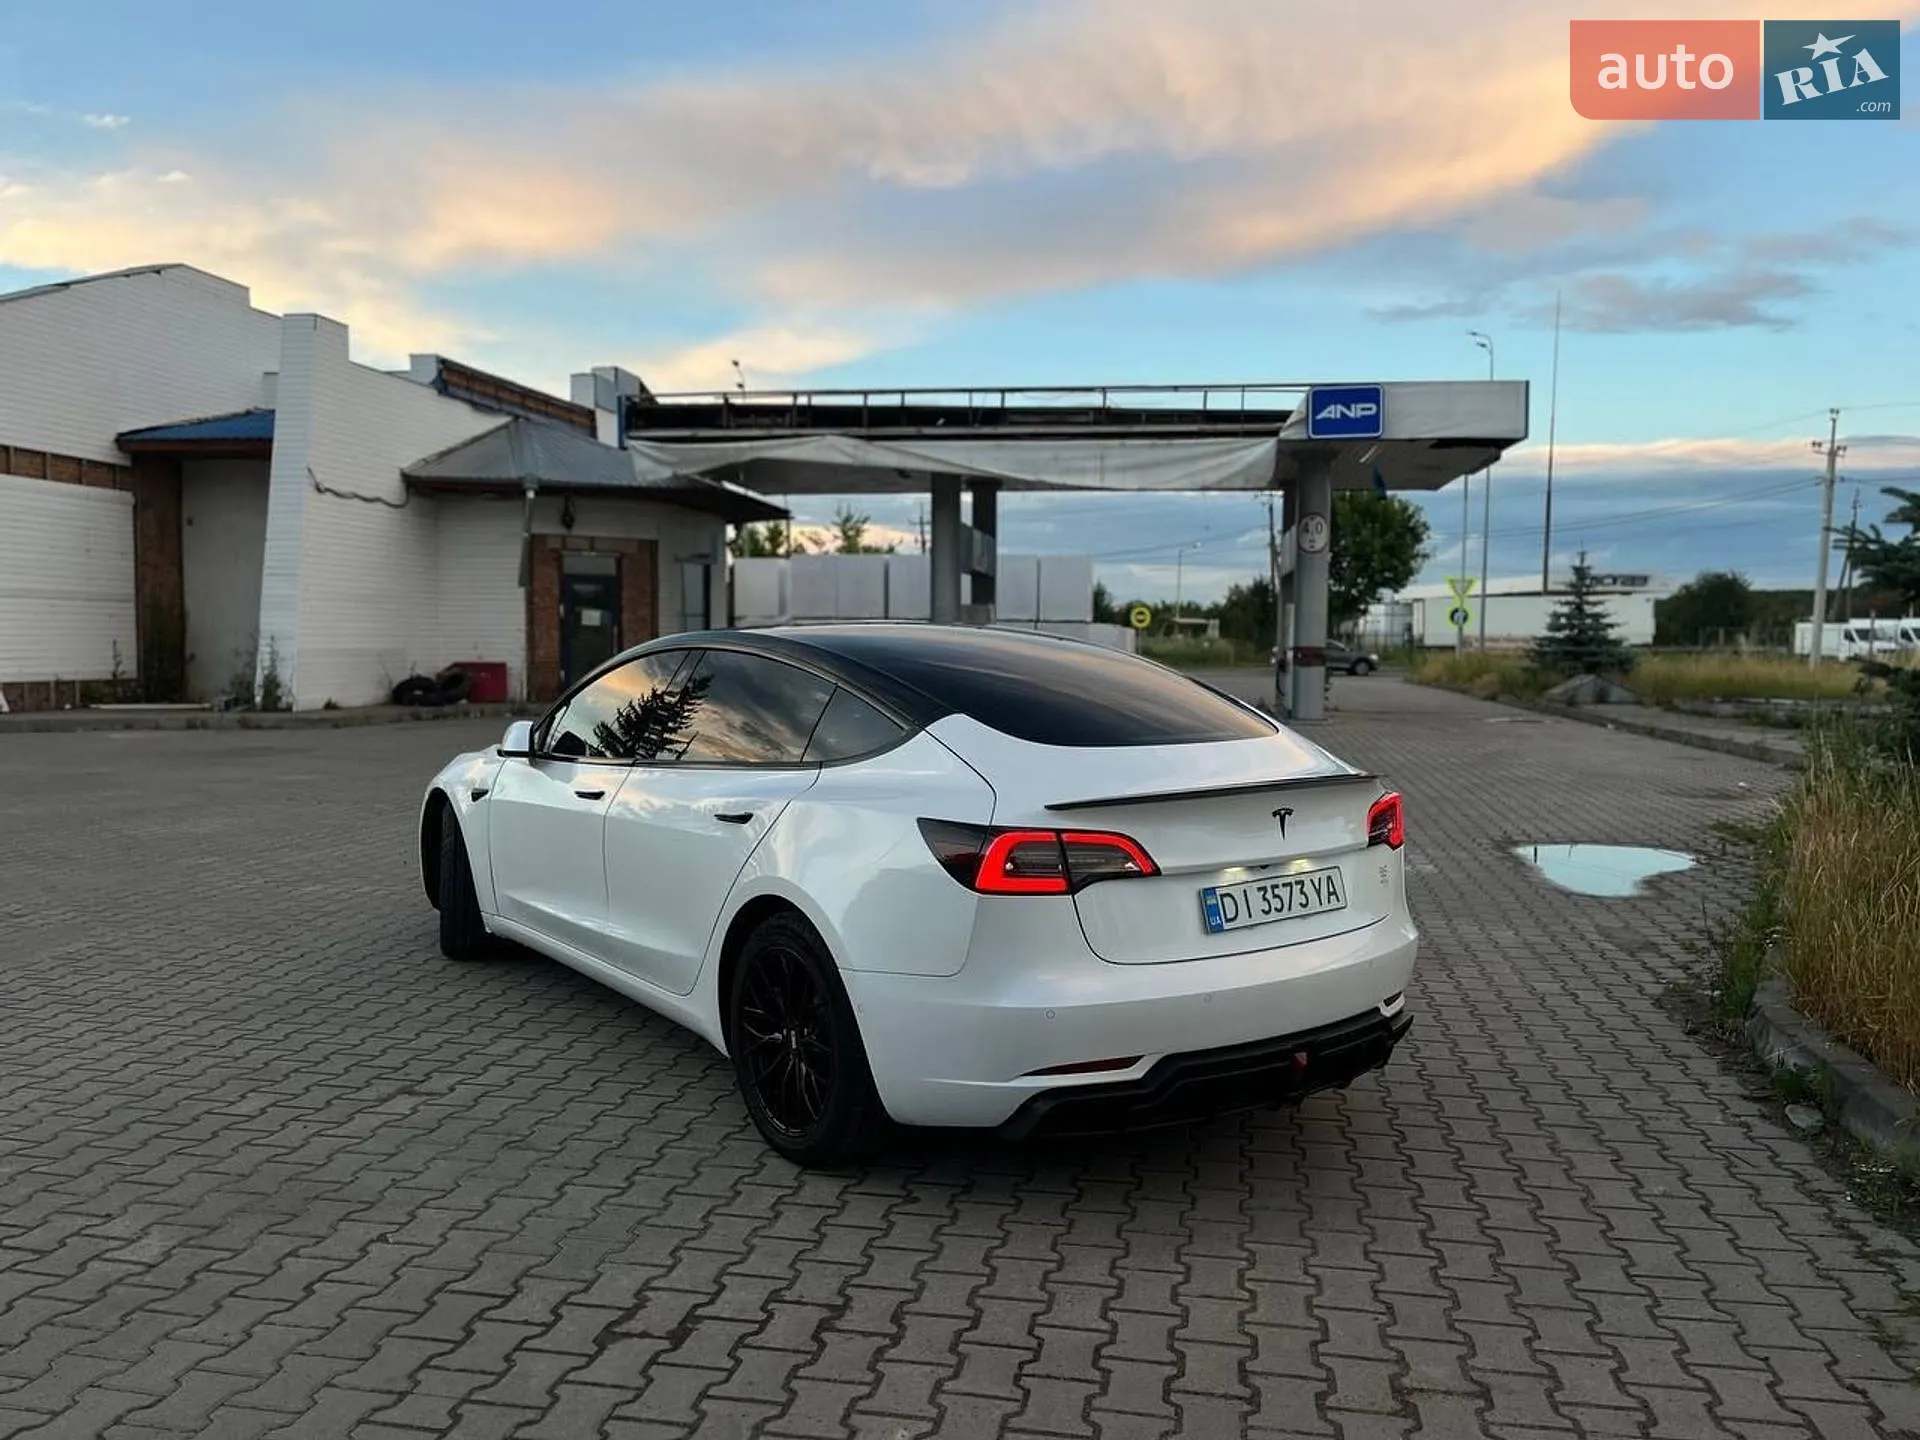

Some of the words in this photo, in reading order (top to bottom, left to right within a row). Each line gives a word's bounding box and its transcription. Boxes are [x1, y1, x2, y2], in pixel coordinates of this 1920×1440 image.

[1315, 403, 1377, 419] ANP
[1220, 889, 1252, 923] DI
[1256, 880, 1310, 916] 3573
[1309, 875, 1341, 906] YA
[1210, 915, 1222, 925] UA
